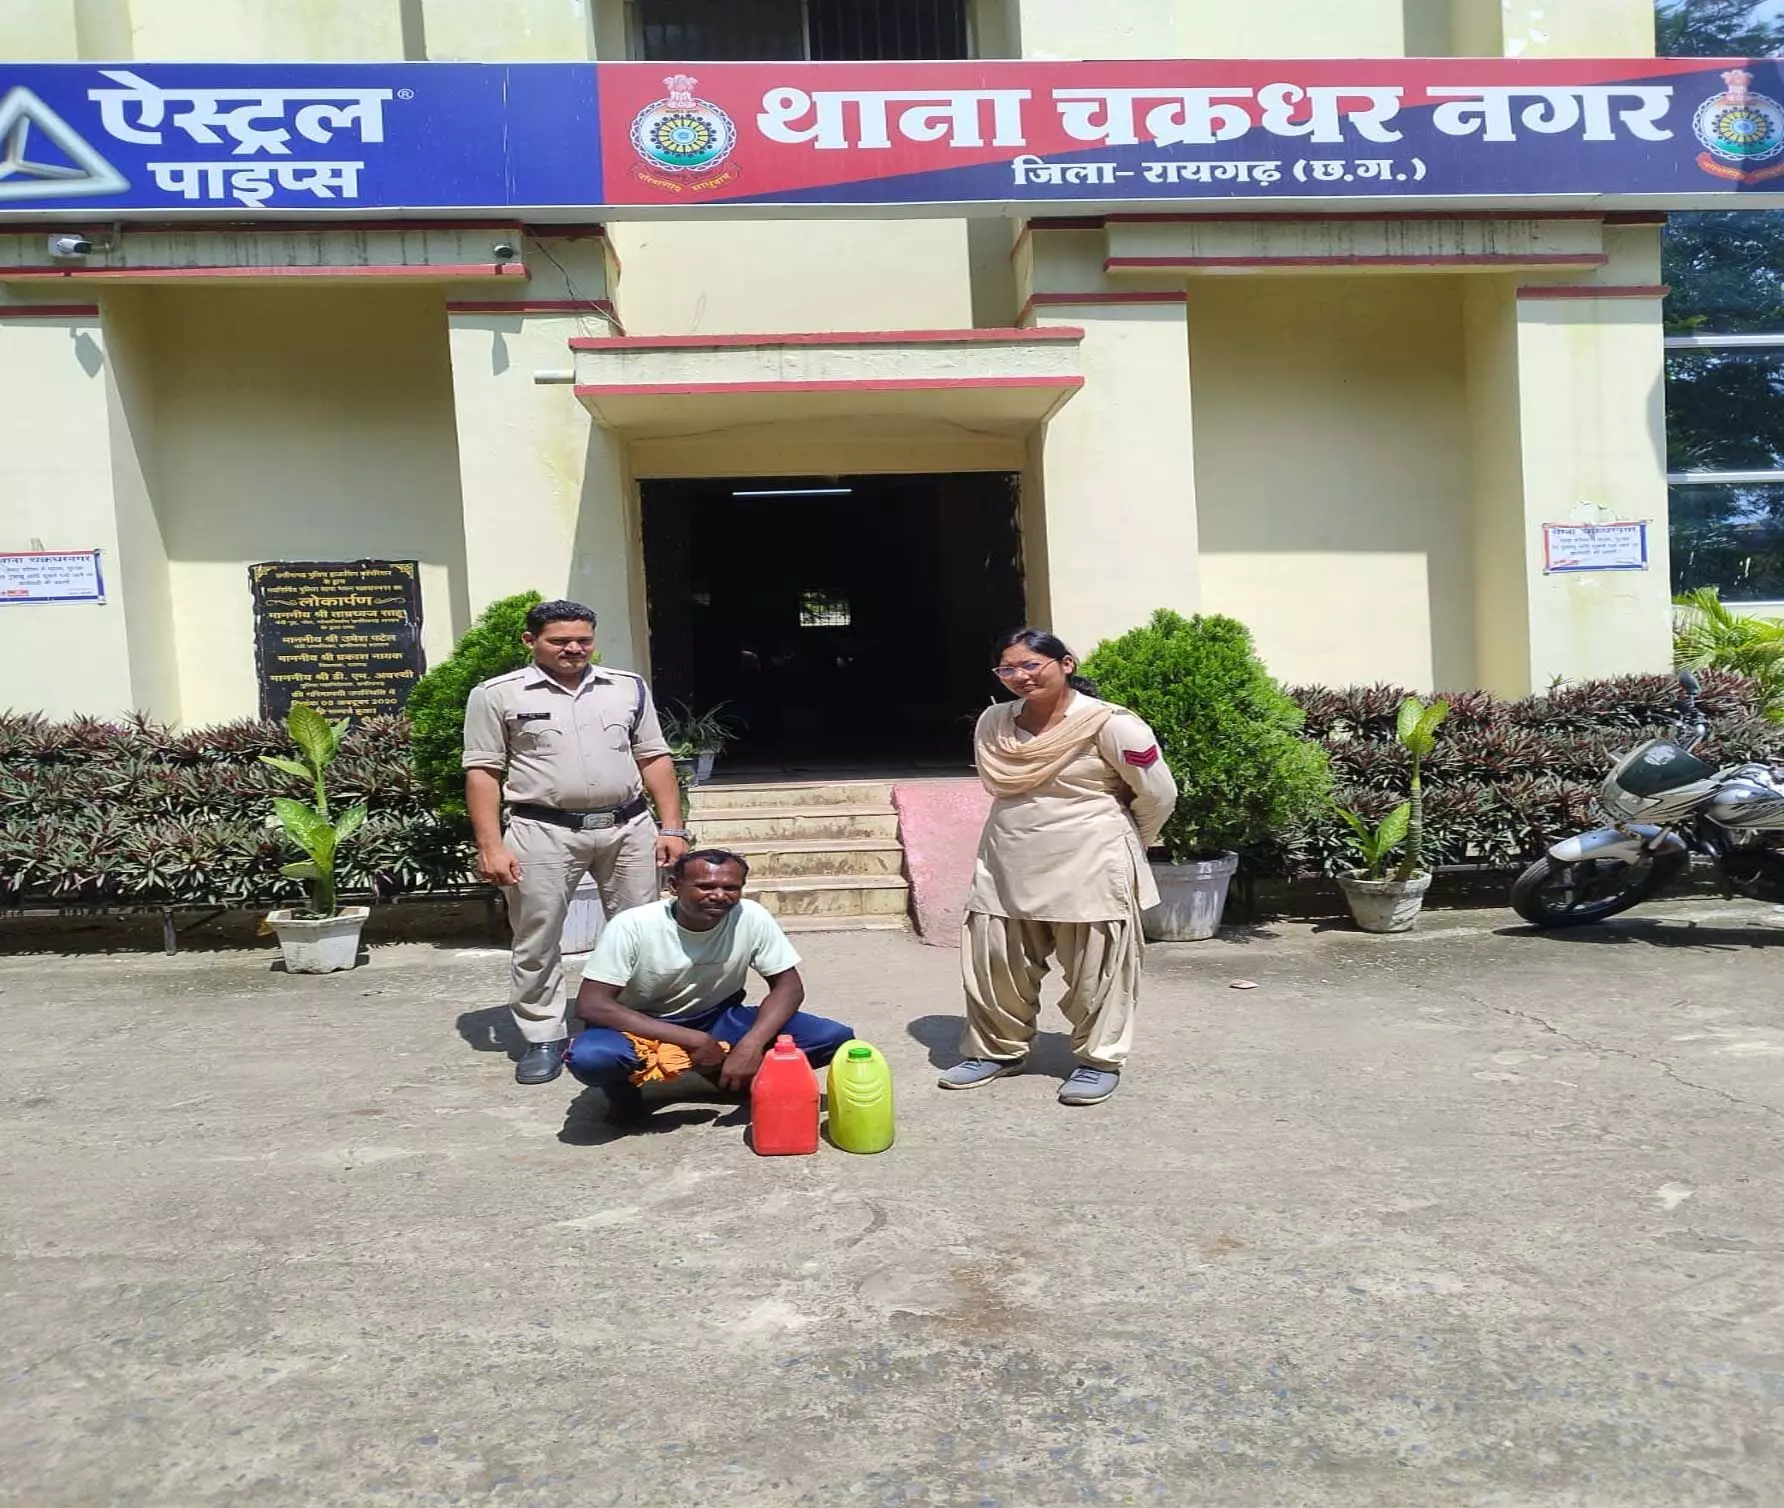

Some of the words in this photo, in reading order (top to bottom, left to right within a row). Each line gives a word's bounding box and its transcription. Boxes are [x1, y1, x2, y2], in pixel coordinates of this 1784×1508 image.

[88, 71, 393, 155] ऐस्ट्रल
[756, 87, 1031, 149] थाना
[1052, 82, 1404, 147] चक्रधर
[1426, 86, 1675, 142] नगर
[1141, 160, 1282, 187] रायगढ़
[1293, 157, 1427, 183] (छ.ग.)
[146, 160, 365, 209] पाइप्स
[299, 594, 373, 607] लोकार्पण
[268, 610, 311, 619] माननीय
[314, 609, 328, 618] श्री
[282, 634, 322, 644] माननीय
[325, 633, 338, 643] श्री
[277, 653, 318, 663] माननीय
[321, 652, 334, 661] श्री
[269, 673, 312, 682] माननीय
[315, 671, 329, 682] श्री
